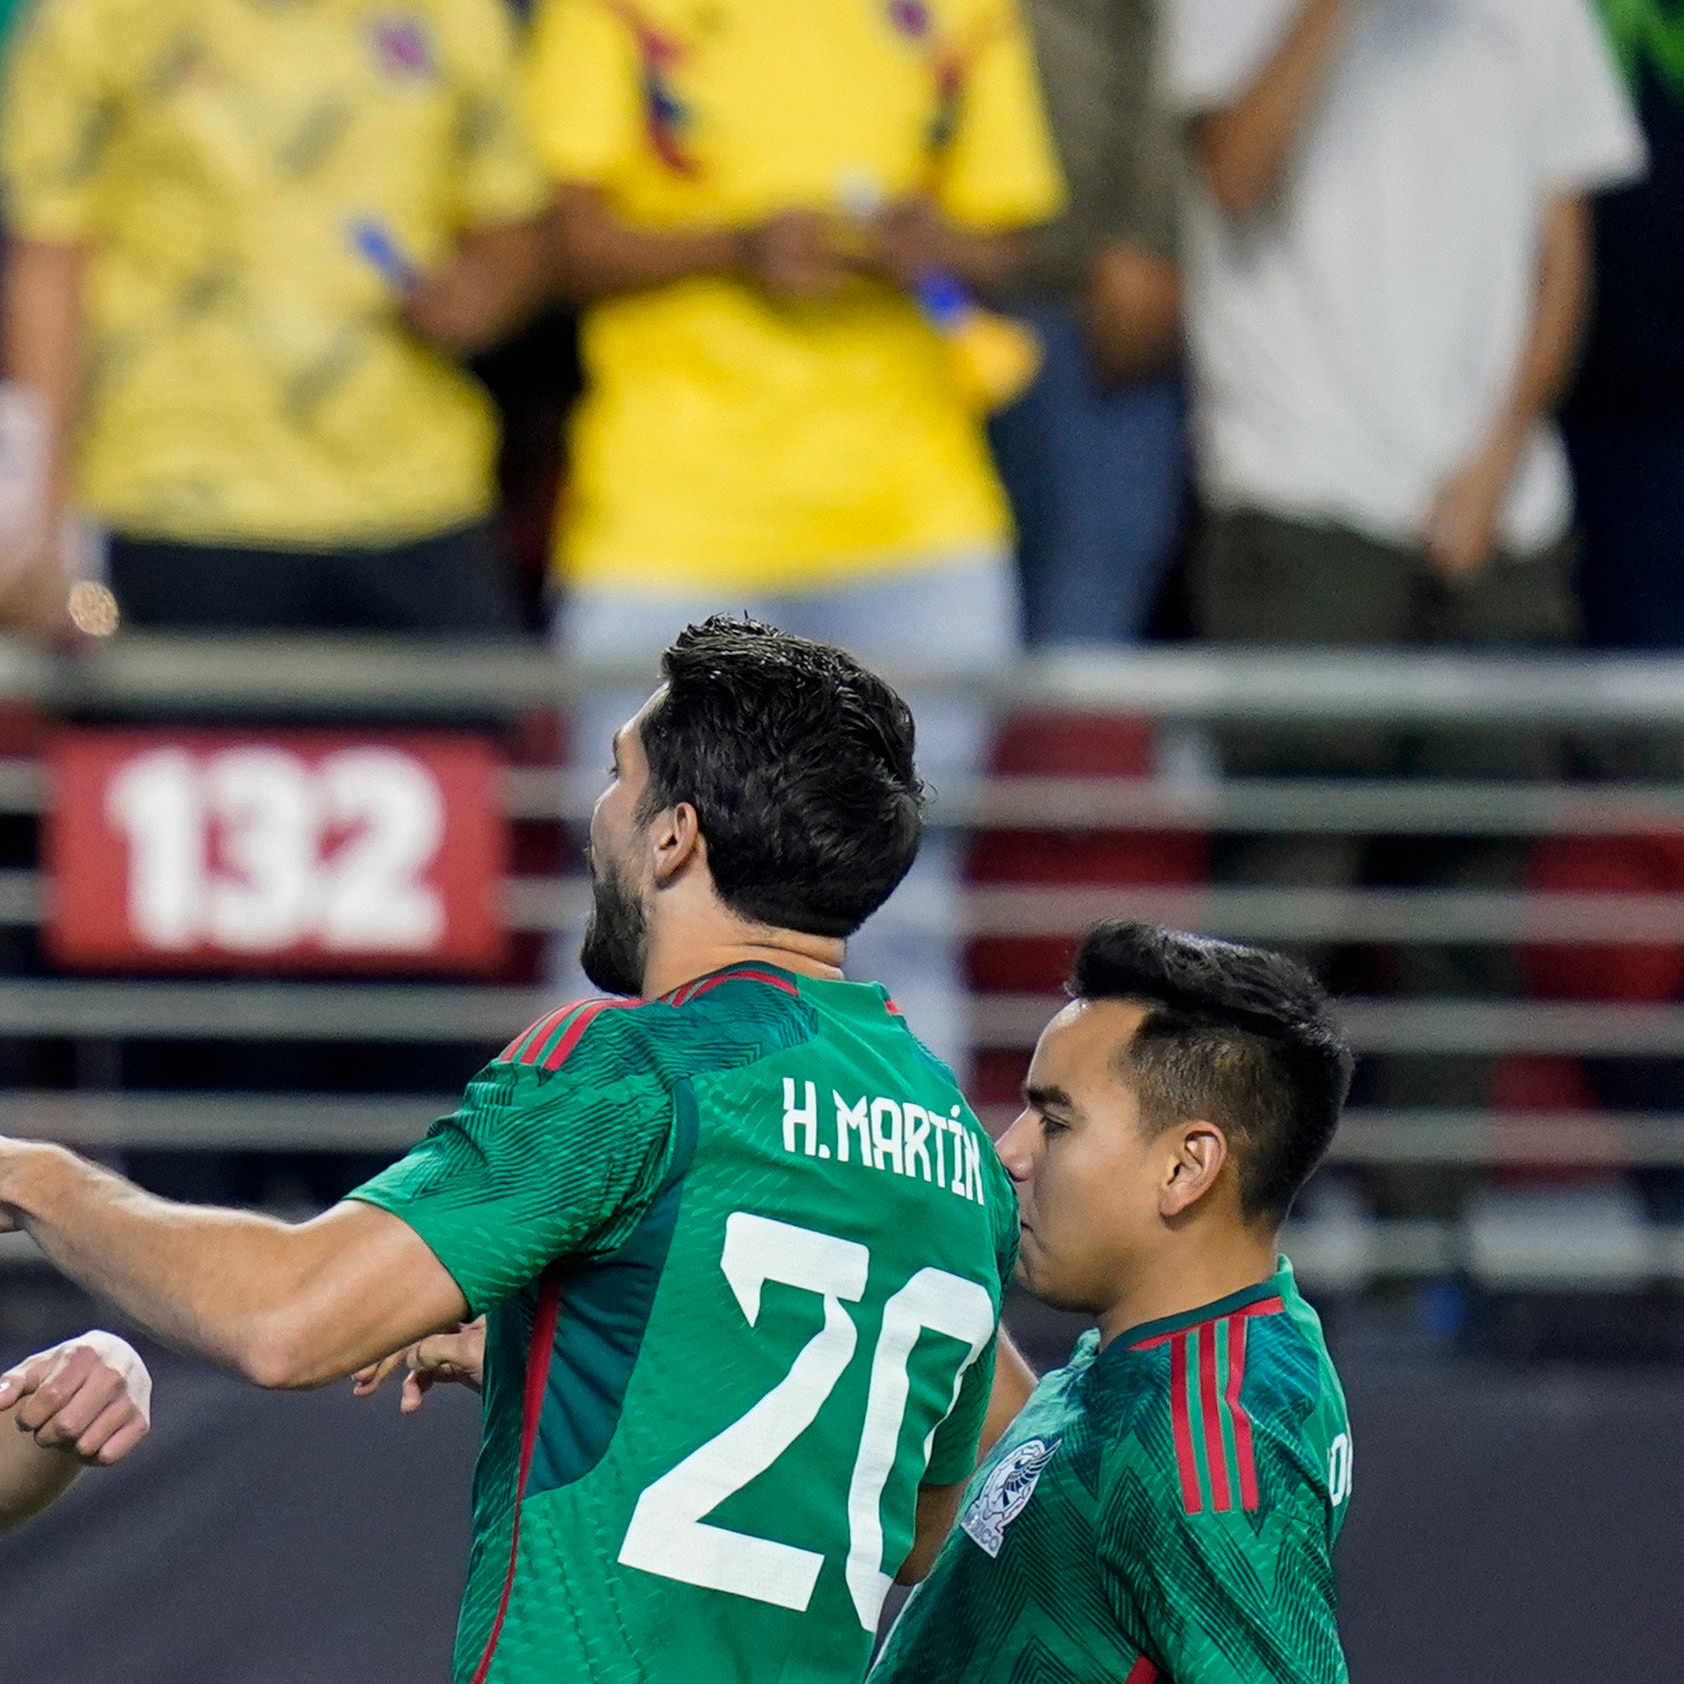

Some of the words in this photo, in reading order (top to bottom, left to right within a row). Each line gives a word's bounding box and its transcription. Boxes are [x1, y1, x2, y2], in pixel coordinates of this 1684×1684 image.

[101, 744, 445, 952] 132
[783, 1077, 985, 1206] H.MARTÍN
[617, 1211, 994, 1633] 20
